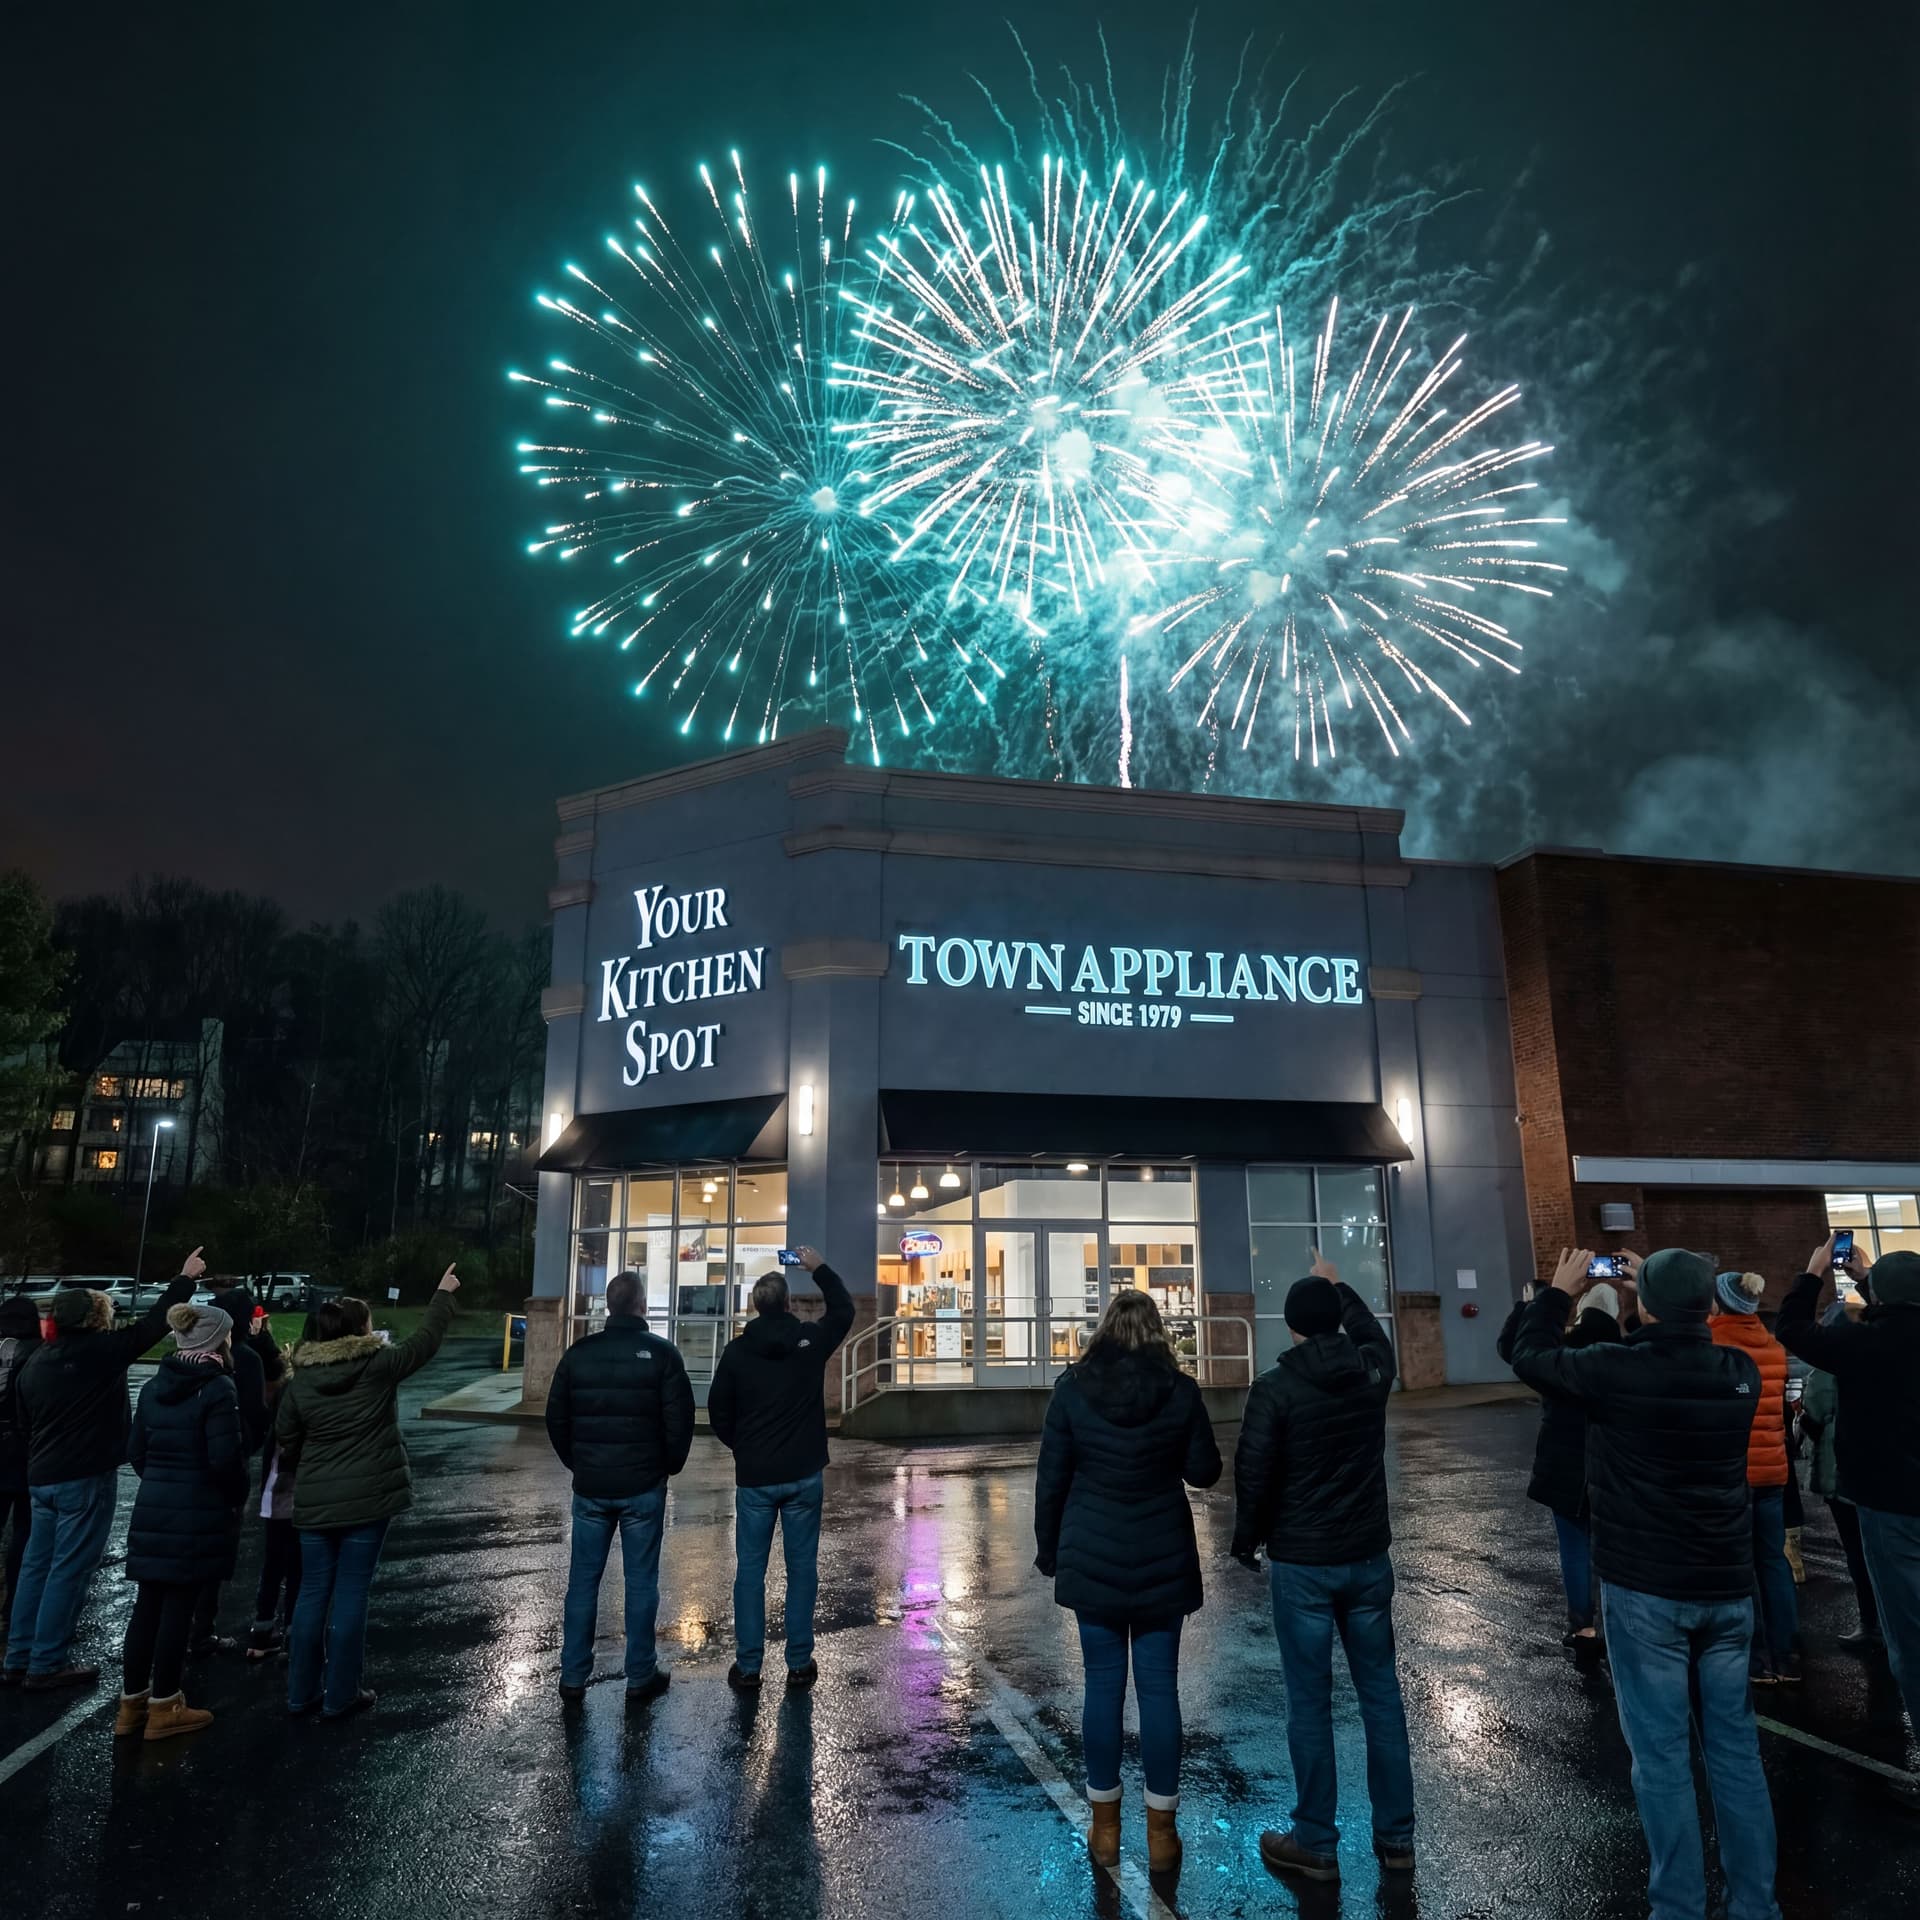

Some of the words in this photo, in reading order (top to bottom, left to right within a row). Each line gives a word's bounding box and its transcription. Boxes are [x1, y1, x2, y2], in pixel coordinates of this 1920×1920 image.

[633, 884, 728, 950] YOUR
[597, 947, 765, 1023] KITCHEN
[898, 934, 1066, 992] TOWN
[1070, 944, 1364, 1005] APPLIANCE
[1077, 1000, 1134, 1027] SINCE
[1138, 1004, 1183, 1029] 1979
[623, 1019, 721, 1087] SPOT
